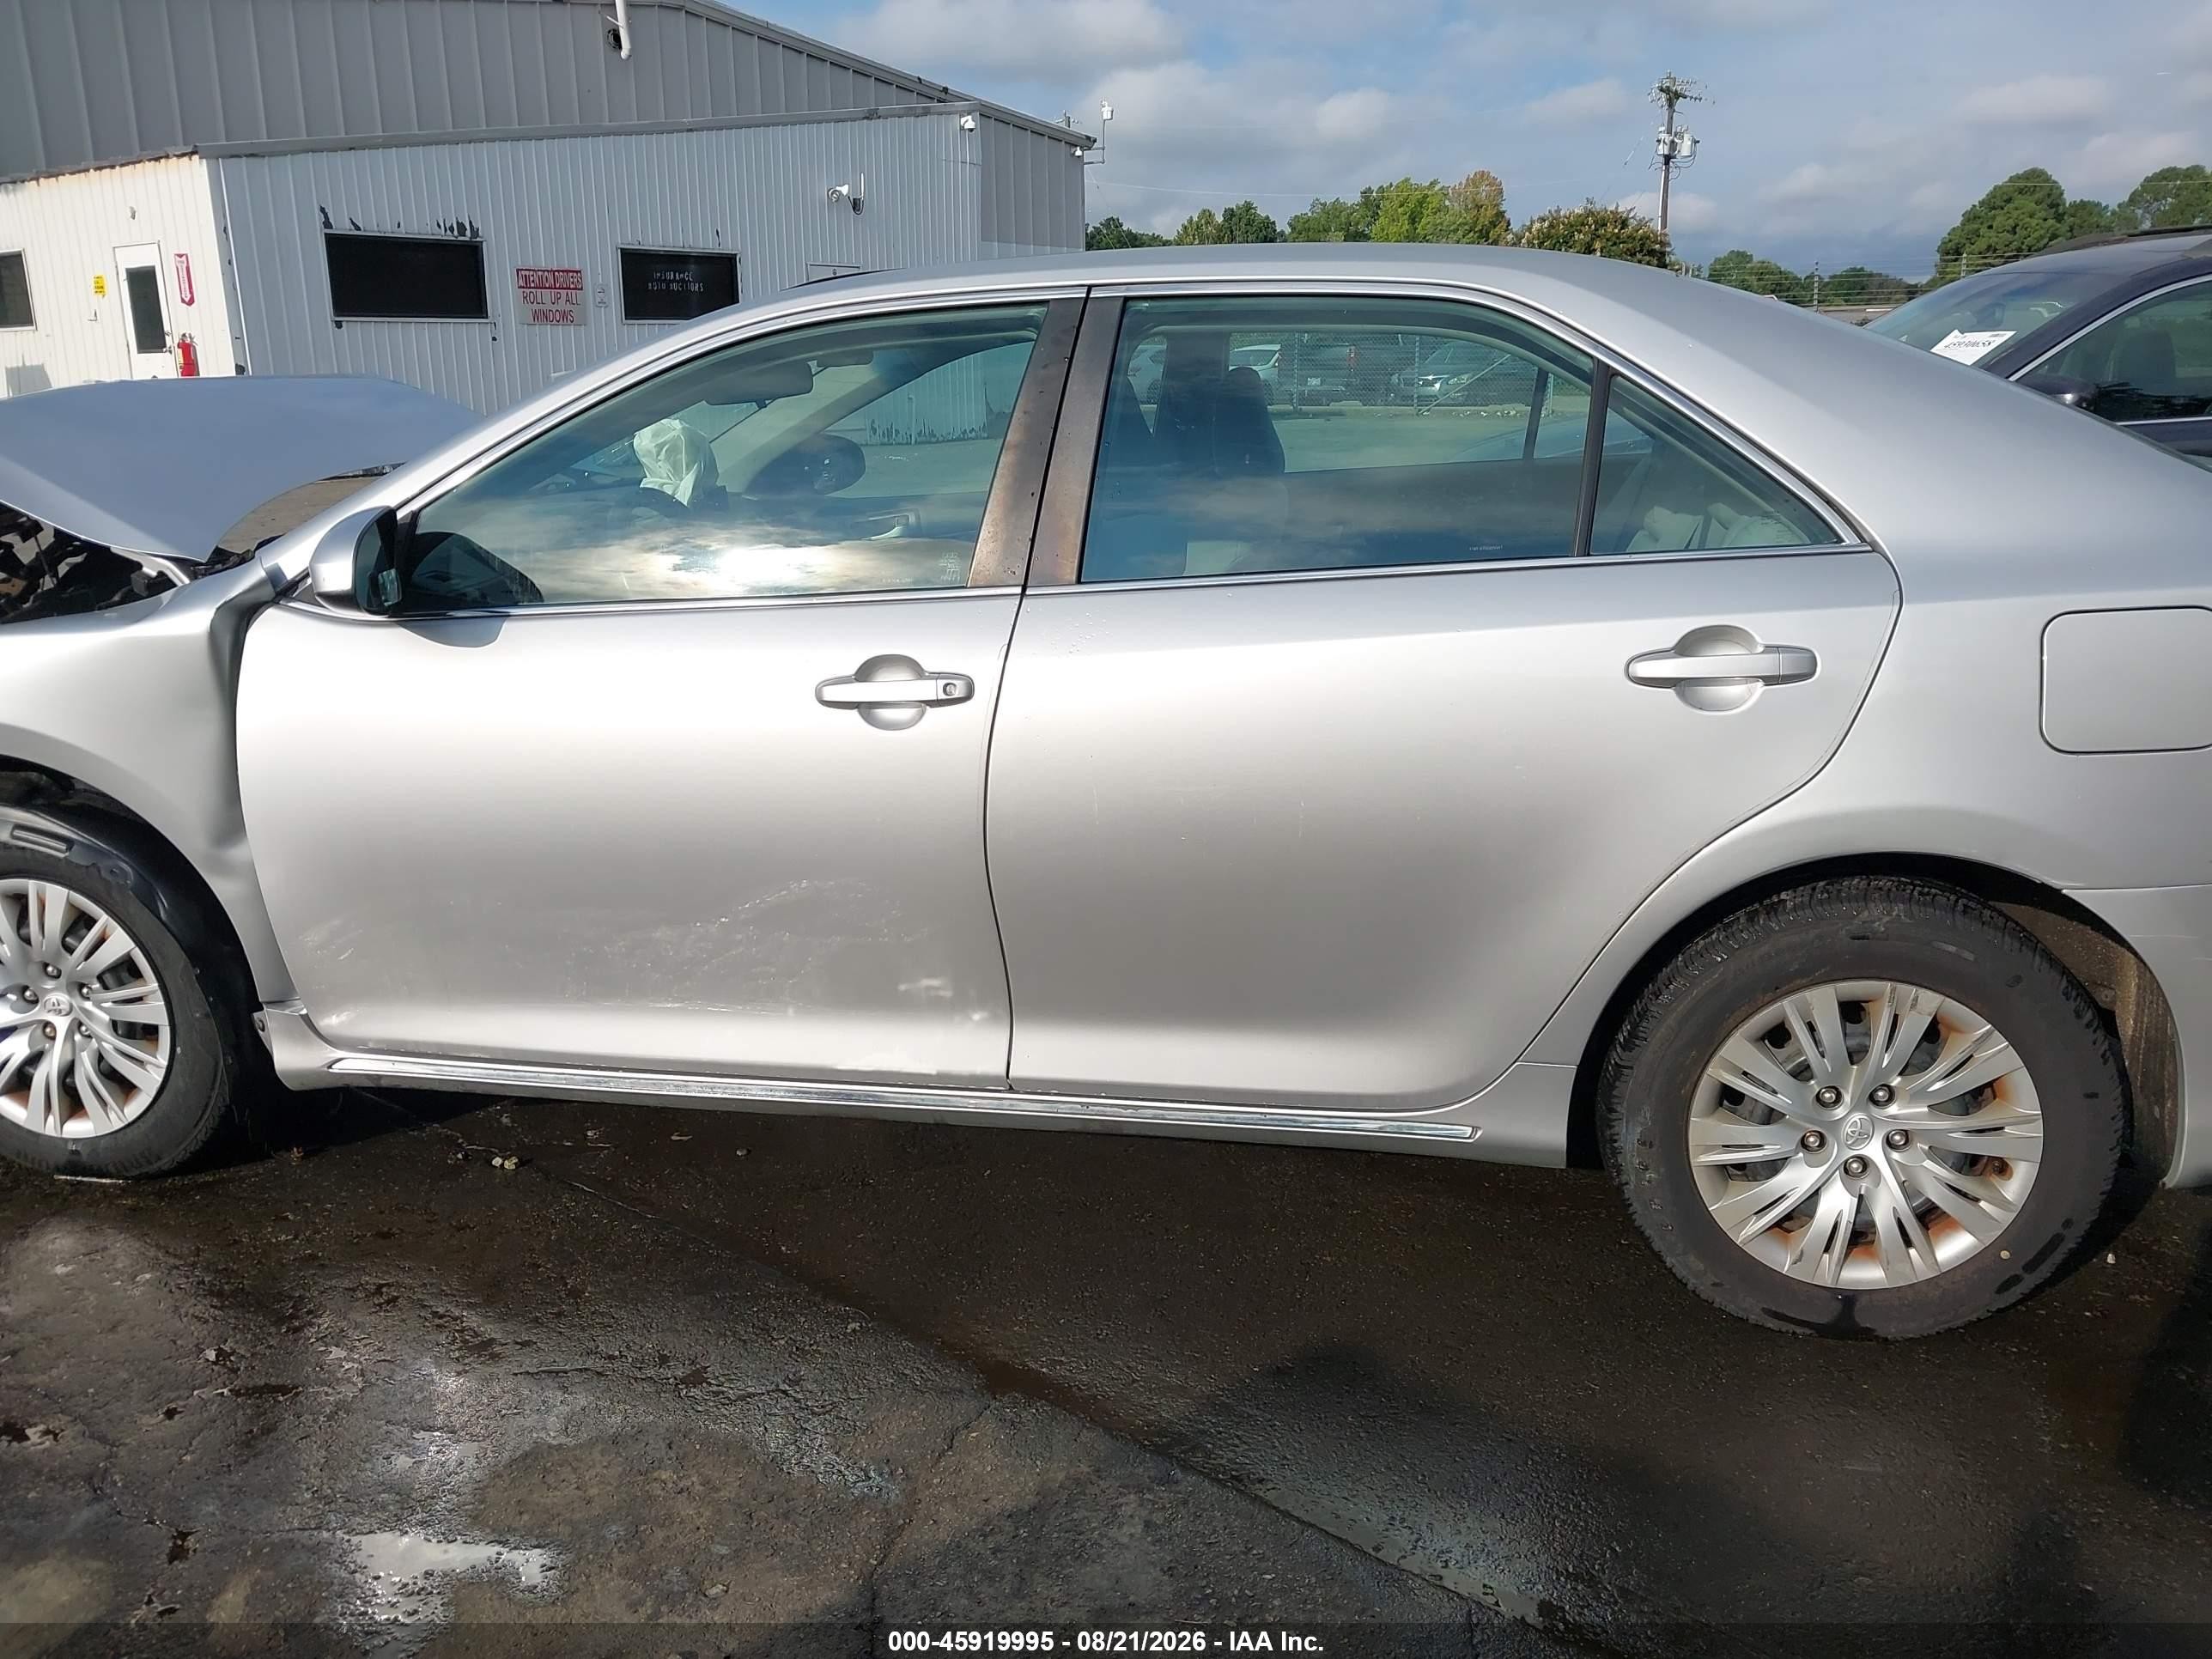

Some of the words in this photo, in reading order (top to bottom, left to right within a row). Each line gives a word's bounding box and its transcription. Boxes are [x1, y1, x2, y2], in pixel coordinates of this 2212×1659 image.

[518, 270, 554, 289] ATTENTION
[555, 271, 582, 289] DRIVERS
[522, 291, 545, 305] ROLL
[550, 291, 562, 305] UP
[565, 291, 581, 306] ALL
[531, 308, 574, 323] WINDOWS
